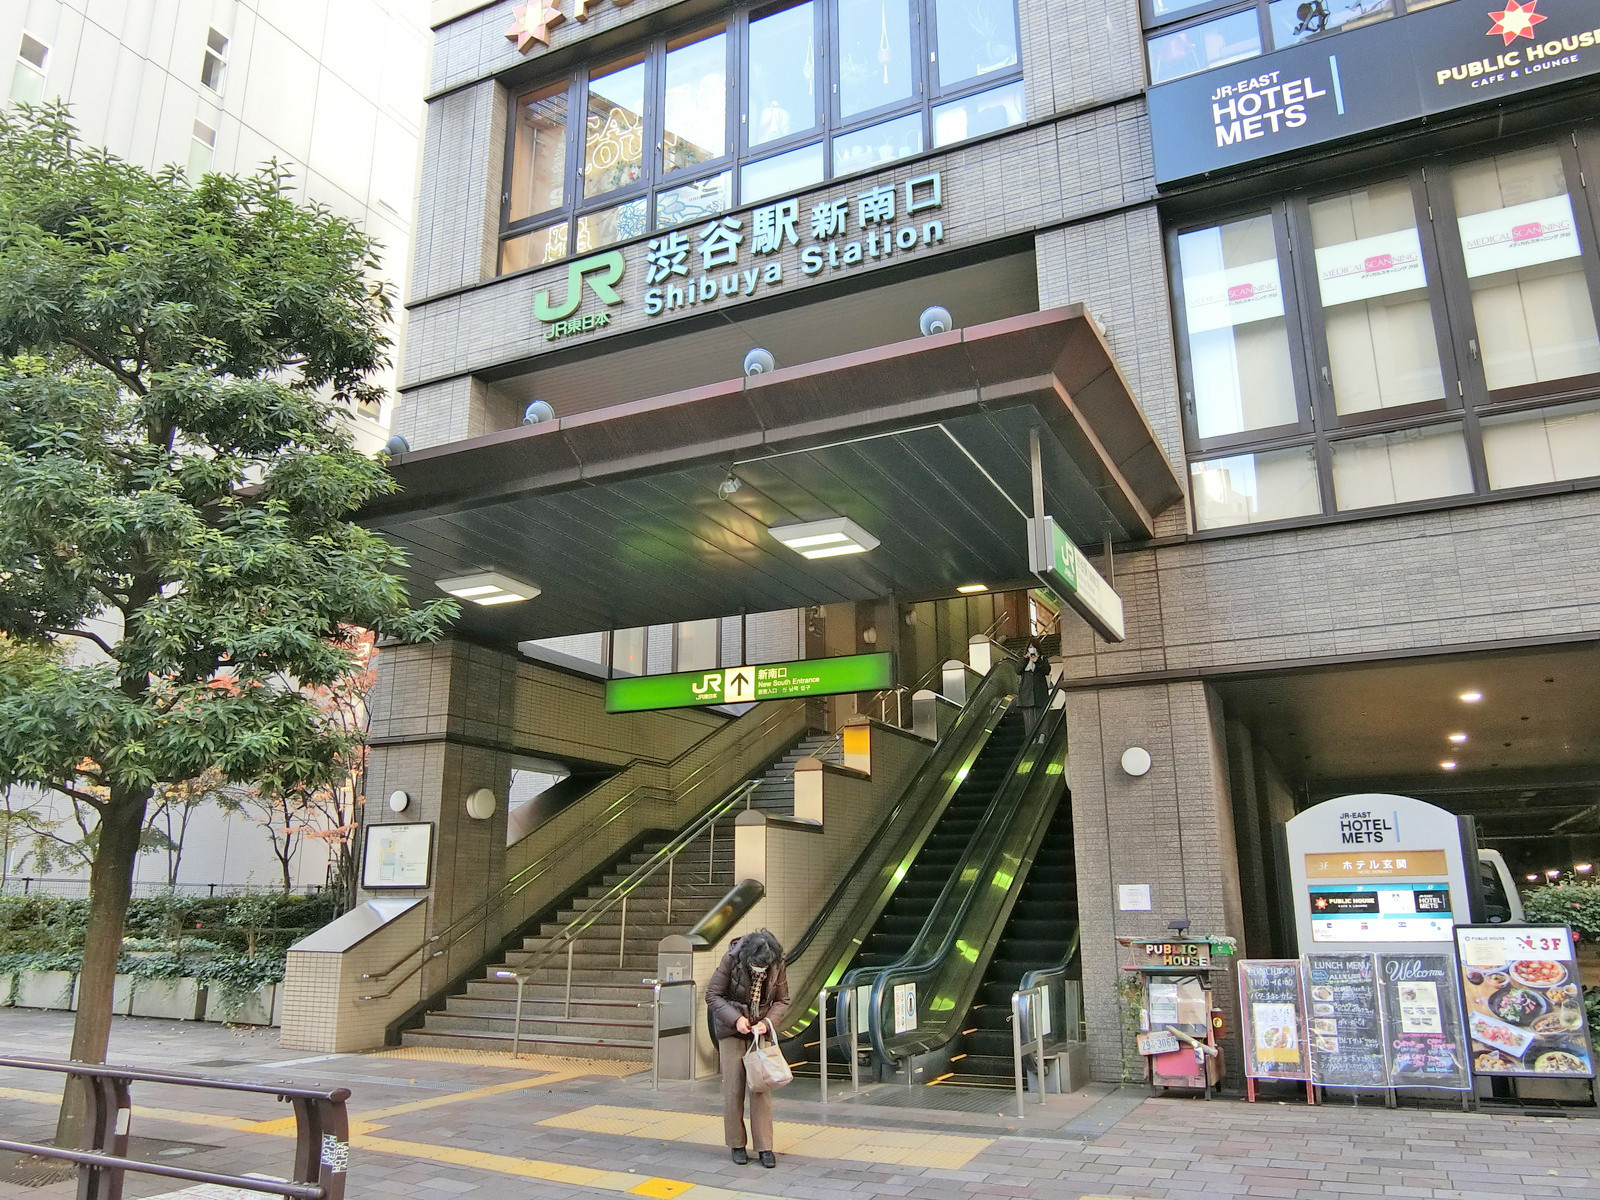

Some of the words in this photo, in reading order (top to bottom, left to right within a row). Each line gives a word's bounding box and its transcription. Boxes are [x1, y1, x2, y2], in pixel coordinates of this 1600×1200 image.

[1436, 51, 1522, 86] PUBLIC
[1471, 73, 1505, 88] CAFE
[1510, 70, 1519, 78] &
[1525, 53, 1579, 75] LOUNGE
[1211, 71, 1280, 101] JR-EAST
[1212, 77, 1327, 125] HOTEL
[1215, 104, 1308, 148] METS
[646, 197, 801, 286] 渋谷駅
[810, 171, 944, 240] 新南口
[1466, 232, 1512, 249] MEDICAL
[1513, 219, 1570, 238] SCANNING
[643, 257, 784, 316] Shibuya
[800, 219, 944, 276] Station
[1322, 264, 1363, 279] MEDICAL
[1364, 252, 1418, 270] SCANNING
[534, 250, 626, 324] JR
[1228, 282, 1277, 298] SCANNING
[544, 310, 612, 341] JR東日本
[1060, 540, 1075, 575] JR
[692, 673, 722, 694] JR
[757, 667, 787, 680] 新南口
[757, 681, 772, 689] New
[772, 679, 791, 687] South
[792, 677, 820, 685] Entrance
[1339, 811, 1372, 820] JR-EAST
[1340, 818, 1393, 832] HOTEL
[1342, 831, 1384, 844] METS
[1318, 861, 1329, 871] 3F
[1342, 858, 1408, 870] ホテル玄関
[1146, 944, 1197, 955] PUBLIC
[1540, 938, 1561, 951] 3F
[1163, 955, 1207, 967] HOUSE
[1314, 961, 1344, 970] LUNCH
[1345, 960, 1370, 970] MENU
[1385, 959, 1445, 982] Welcome
